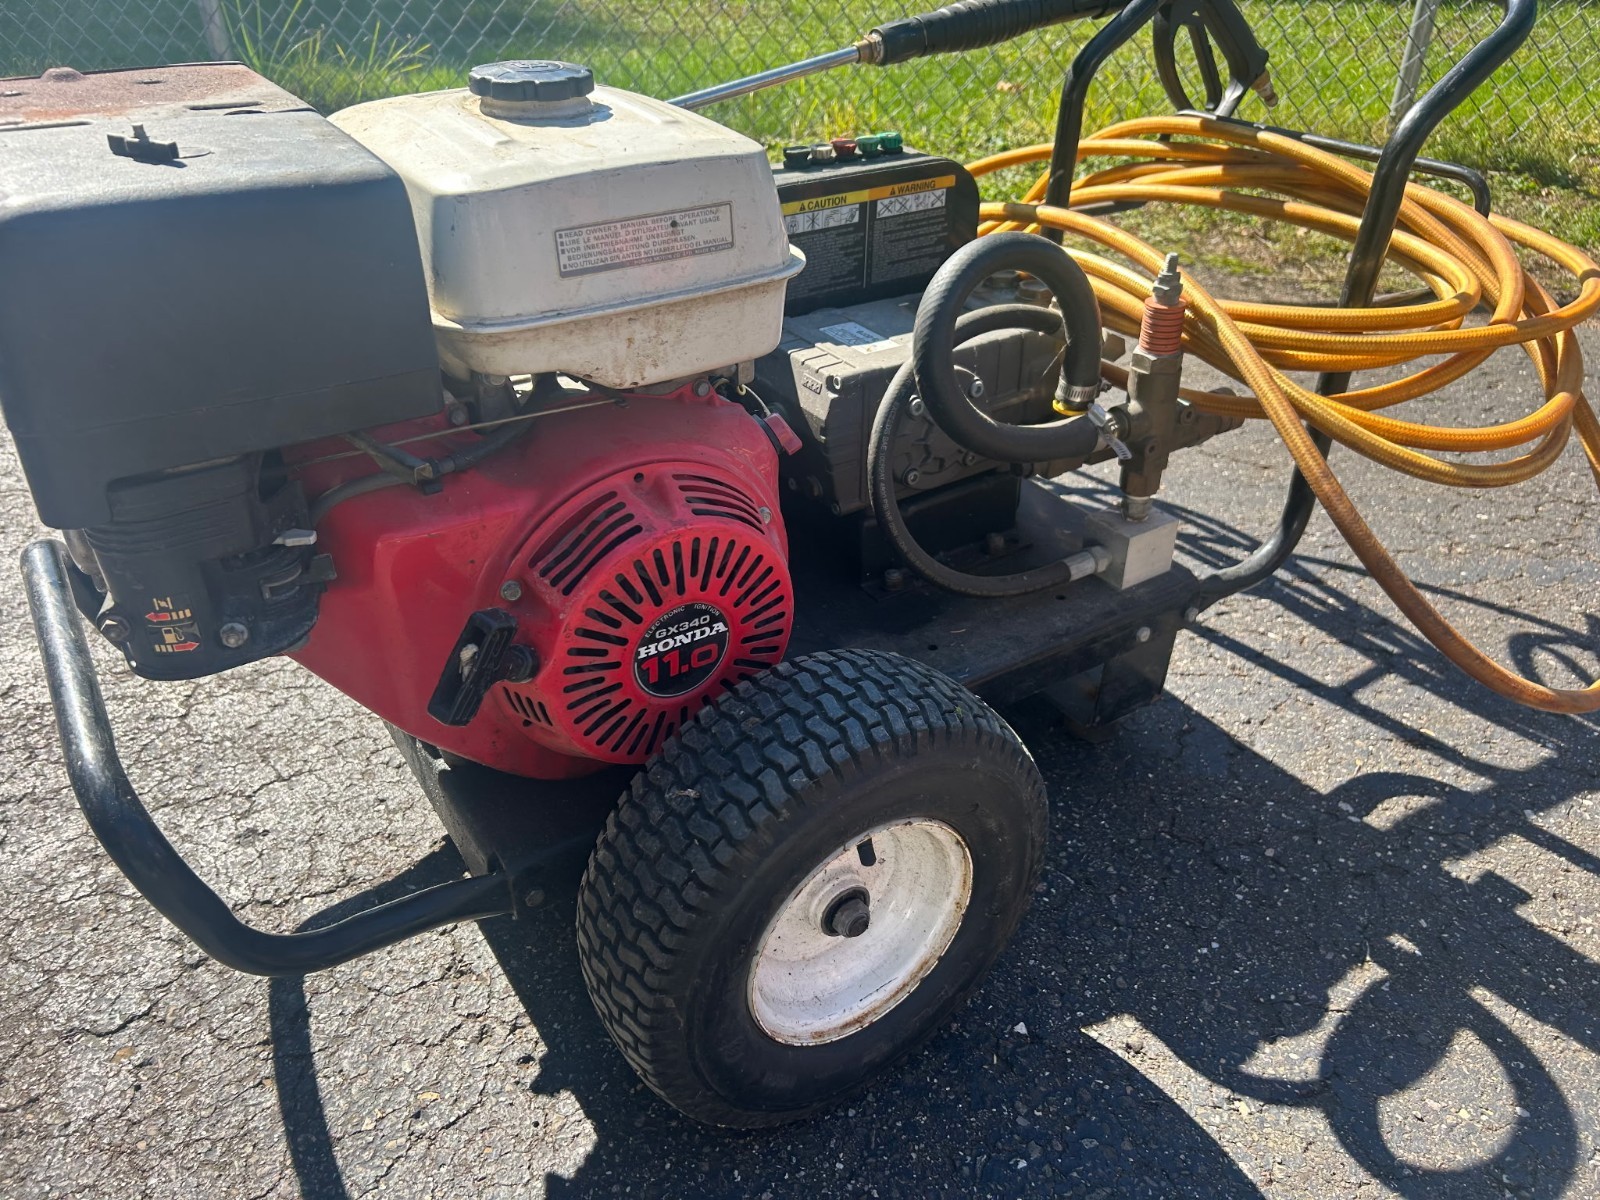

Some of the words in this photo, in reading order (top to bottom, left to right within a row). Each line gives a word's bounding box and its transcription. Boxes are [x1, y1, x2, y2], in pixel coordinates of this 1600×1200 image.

[897, 180, 936, 195] WARNING
[807, 196, 847, 210] CAUTION
[564, 230, 583, 239] READ
[585, 225, 618, 235] OWNER'S
[620, 220, 649, 230] MANUAL
[651, 216, 676, 225] BEFORE
[593, 232, 621, 241] MANUEL
[699, 216, 720, 224] USAGE
[566, 246, 581, 254] VOR
[579, 257, 608, 267] UTILIZAR
[621, 252, 642, 260] ANTES
[653, 246, 675, 254] HABER
[702, 237, 728, 246] MANUAL
[645, 606, 686, 638] ELECTRONIC
[694, 604, 720, 616] IGNITION
[655, 615, 710, 639] GX340
[638, 622, 728, 659] HONDA
[641, 643, 718, 684] 11.0
